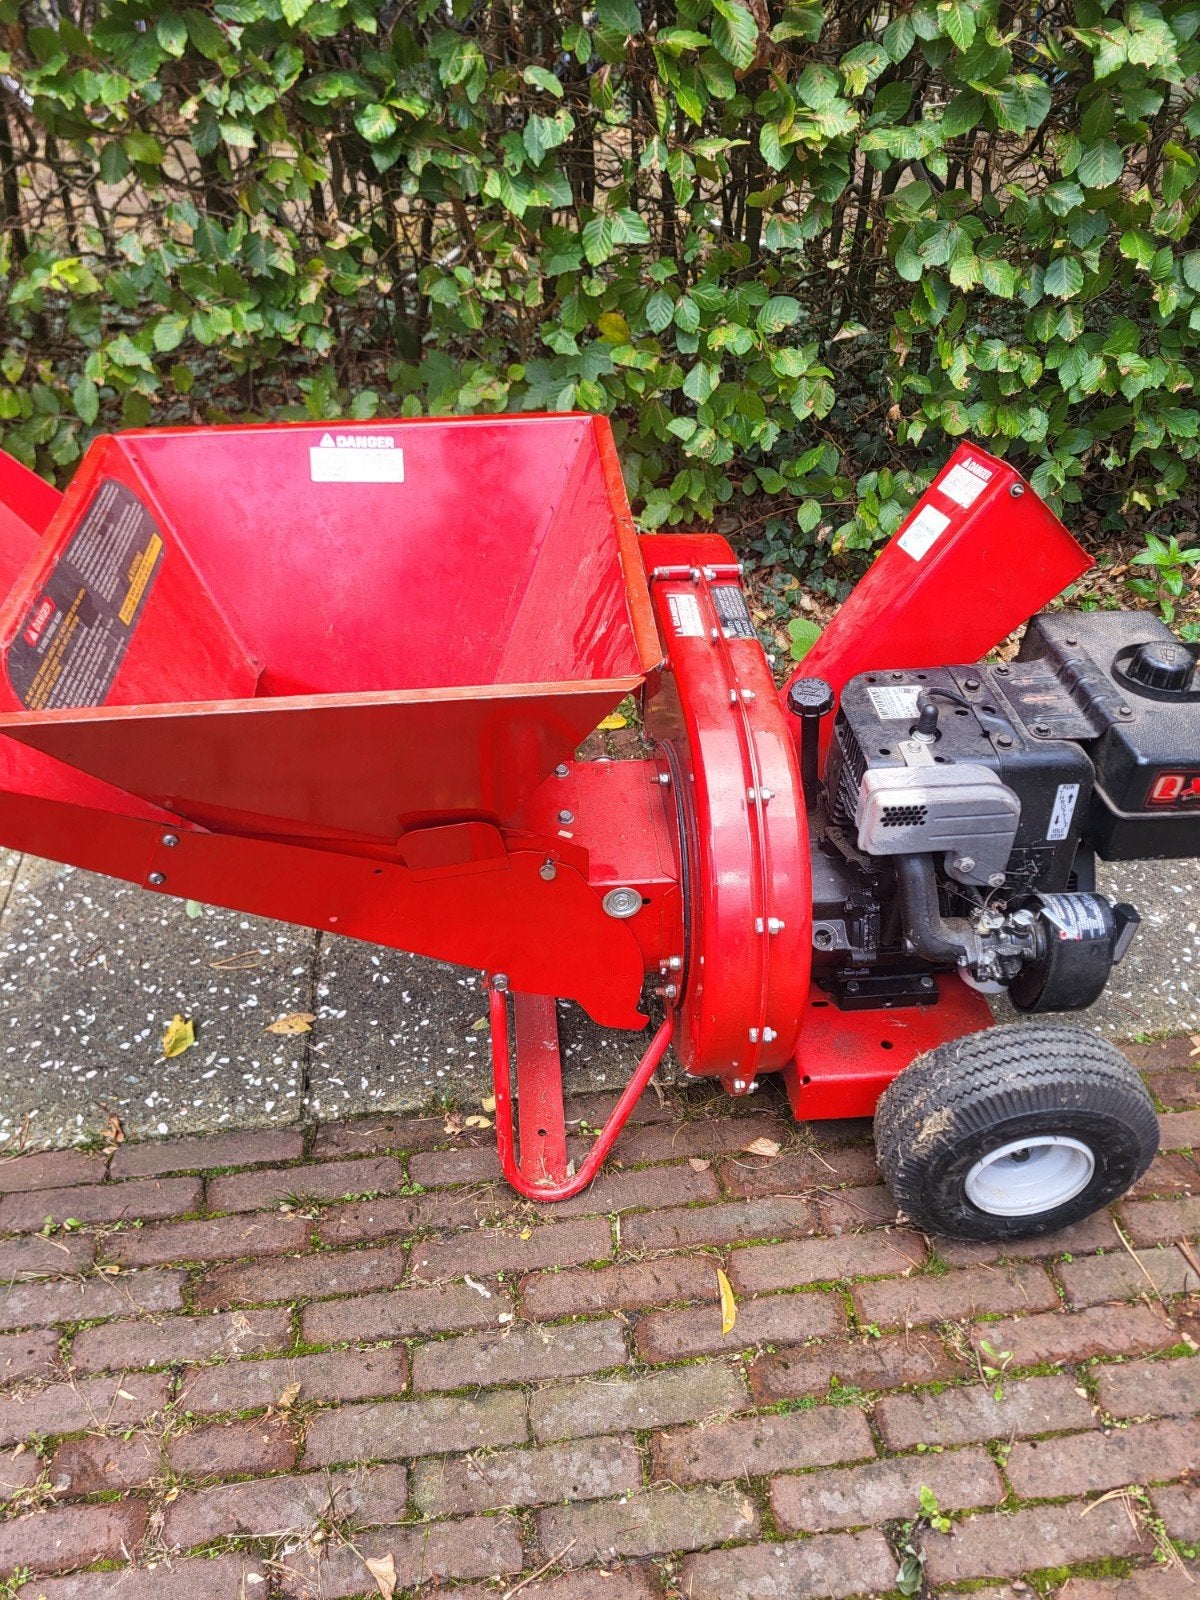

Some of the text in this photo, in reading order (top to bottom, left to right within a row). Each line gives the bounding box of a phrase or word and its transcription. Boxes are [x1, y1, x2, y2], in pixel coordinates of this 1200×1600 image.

[336, 434, 395, 448] DANGER
[967, 461, 993, 480] DANGER
[32, 601, 52, 631] DANGER
[668, 597, 681, 626] DANGER
